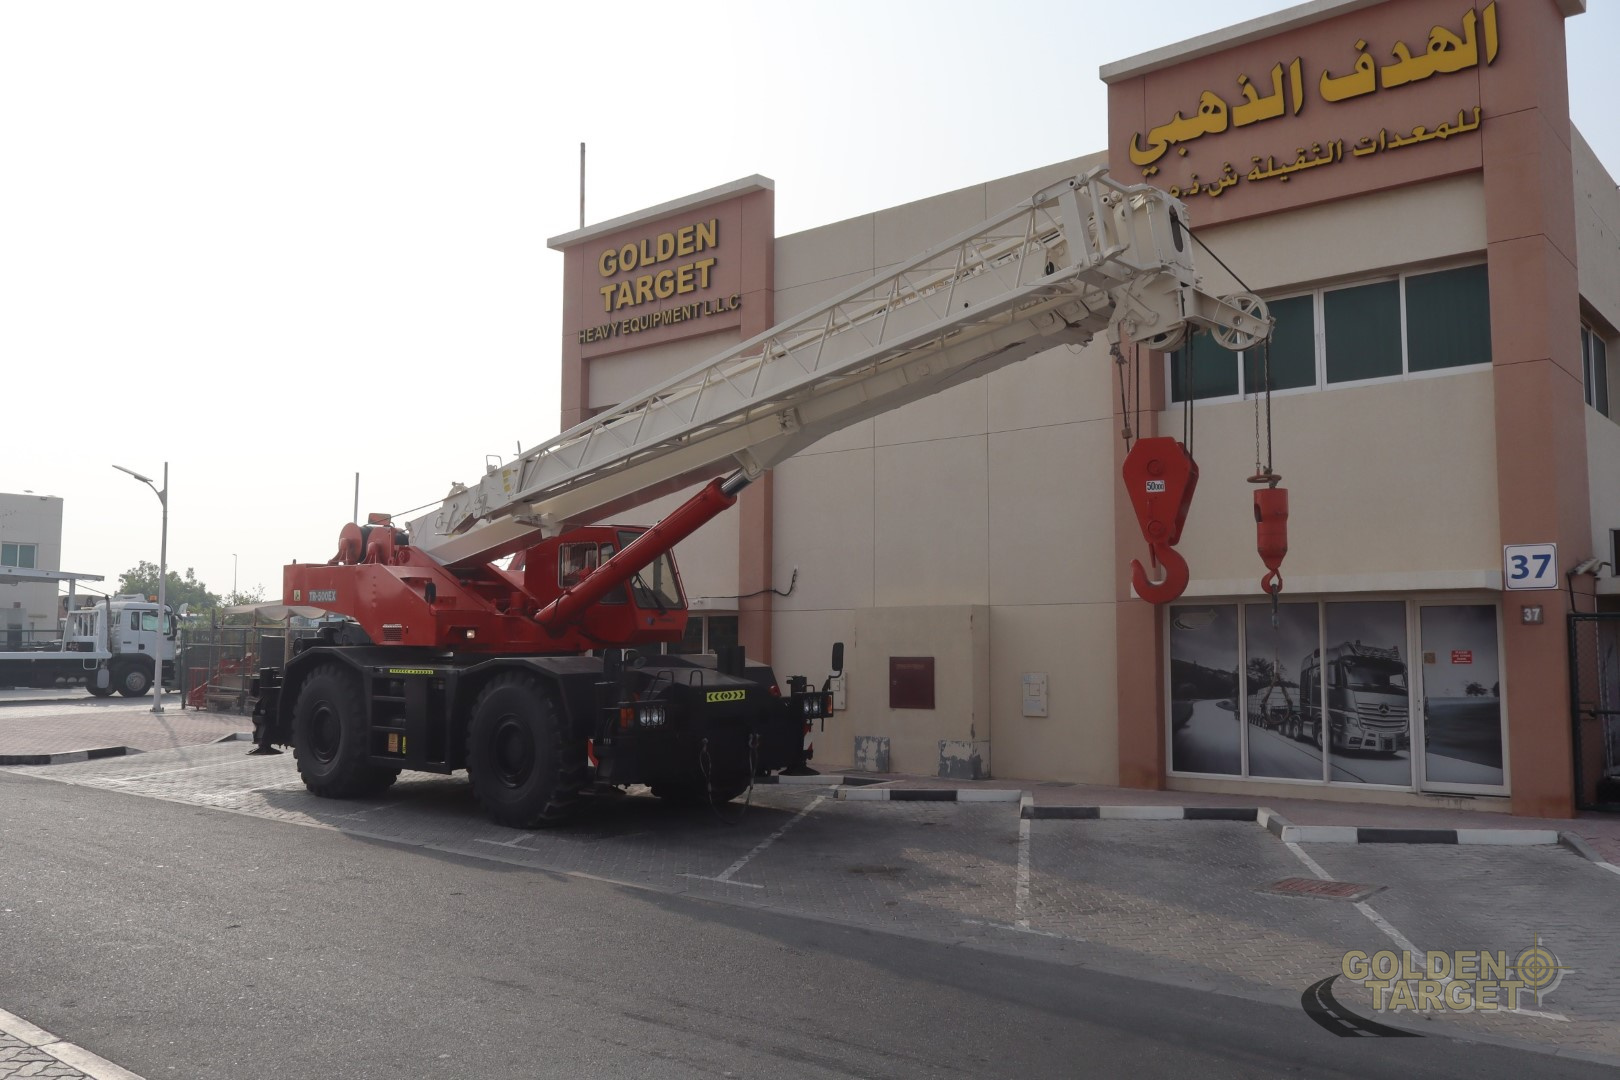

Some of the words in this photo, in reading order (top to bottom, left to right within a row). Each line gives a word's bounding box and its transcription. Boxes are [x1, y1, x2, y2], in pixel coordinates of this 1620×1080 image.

[1319, 1, 1498, 102] الهدف
[1129, 56, 1304, 177] الذهبي
[1352, 106, 1481, 158] للمعدات
[1247, 138, 1344, 182] الثقيلة
[598, 218, 718, 278] GOLDEN
[600, 257, 717, 312] TARGET
[578, 322, 619, 344] HEAVY
[622, 302, 701, 335] EQUIPMENT
[1511, 554, 1551, 579] 37
[1523, 607, 1541, 622] 37
